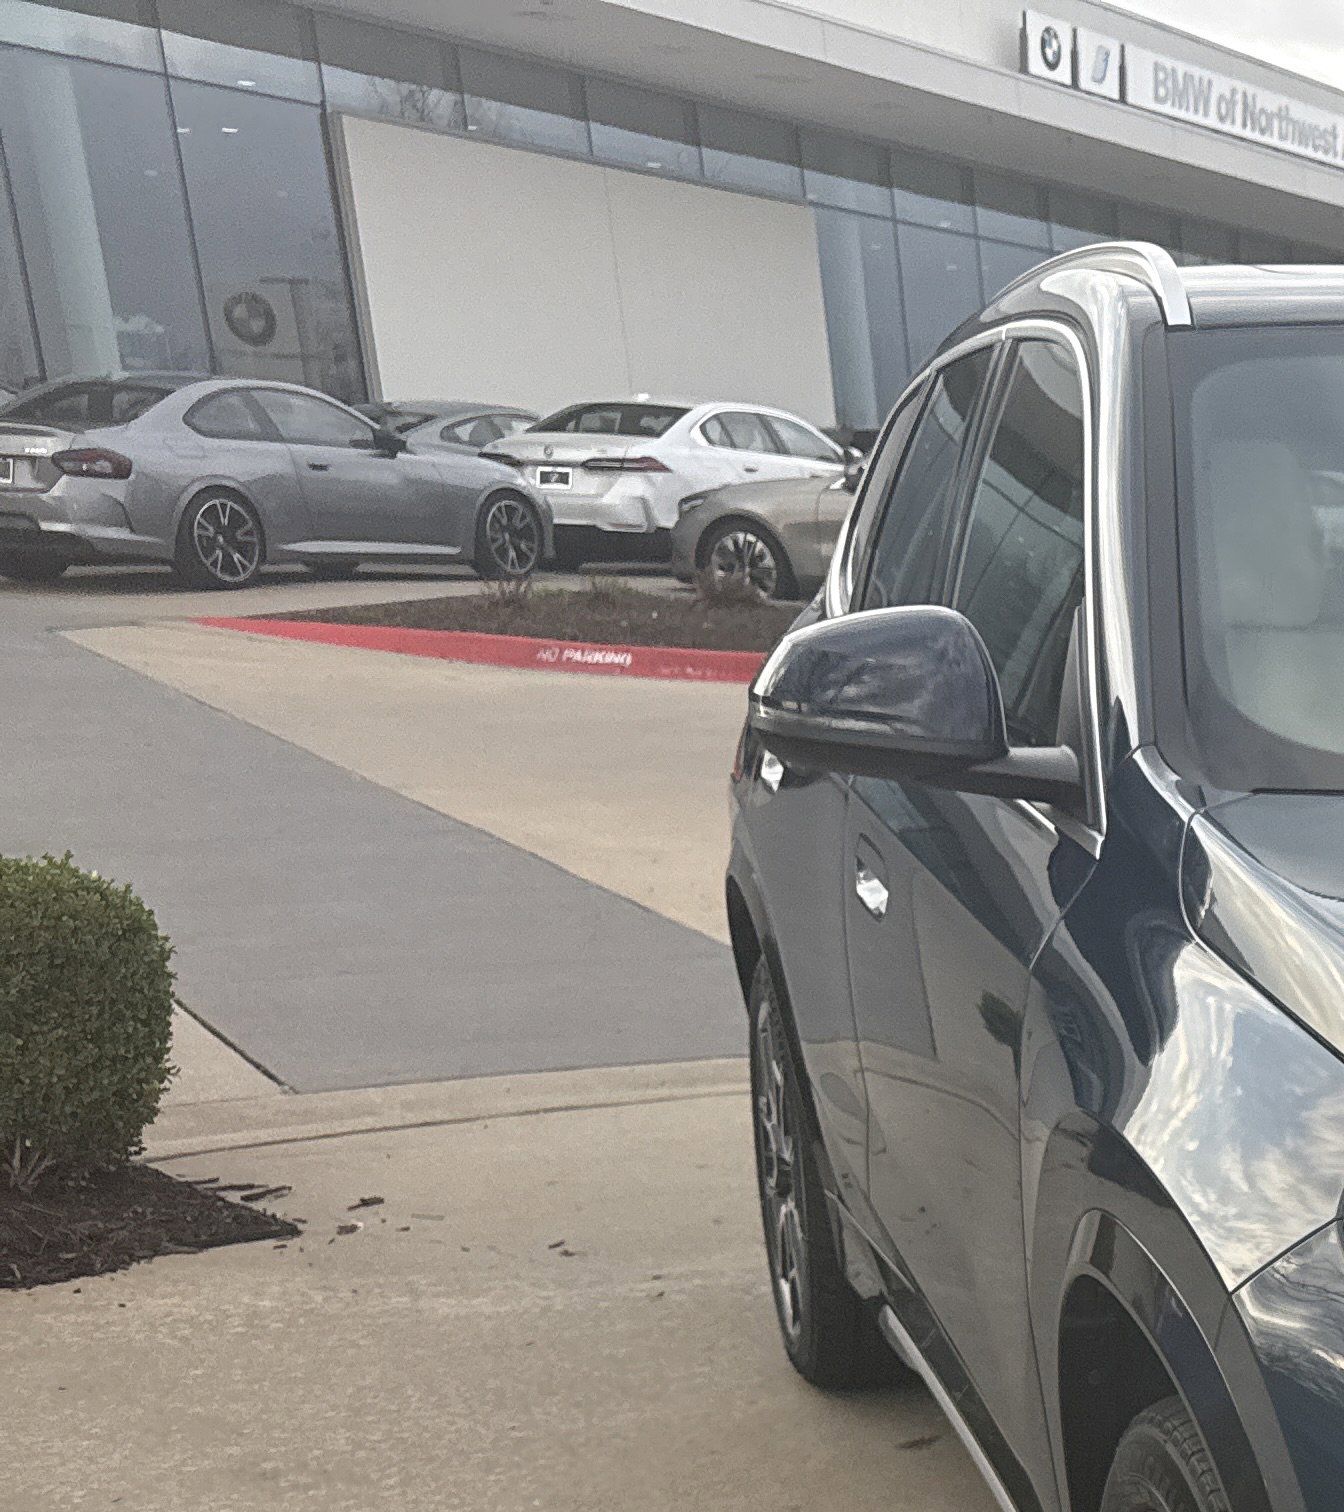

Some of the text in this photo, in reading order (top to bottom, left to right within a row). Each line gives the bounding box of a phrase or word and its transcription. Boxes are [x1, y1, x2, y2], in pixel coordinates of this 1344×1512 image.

[1153, 62, 1213, 118] BMW
[1216, 87, 1238, 126] of
[1241, 89, 1338, 159] Northwest
